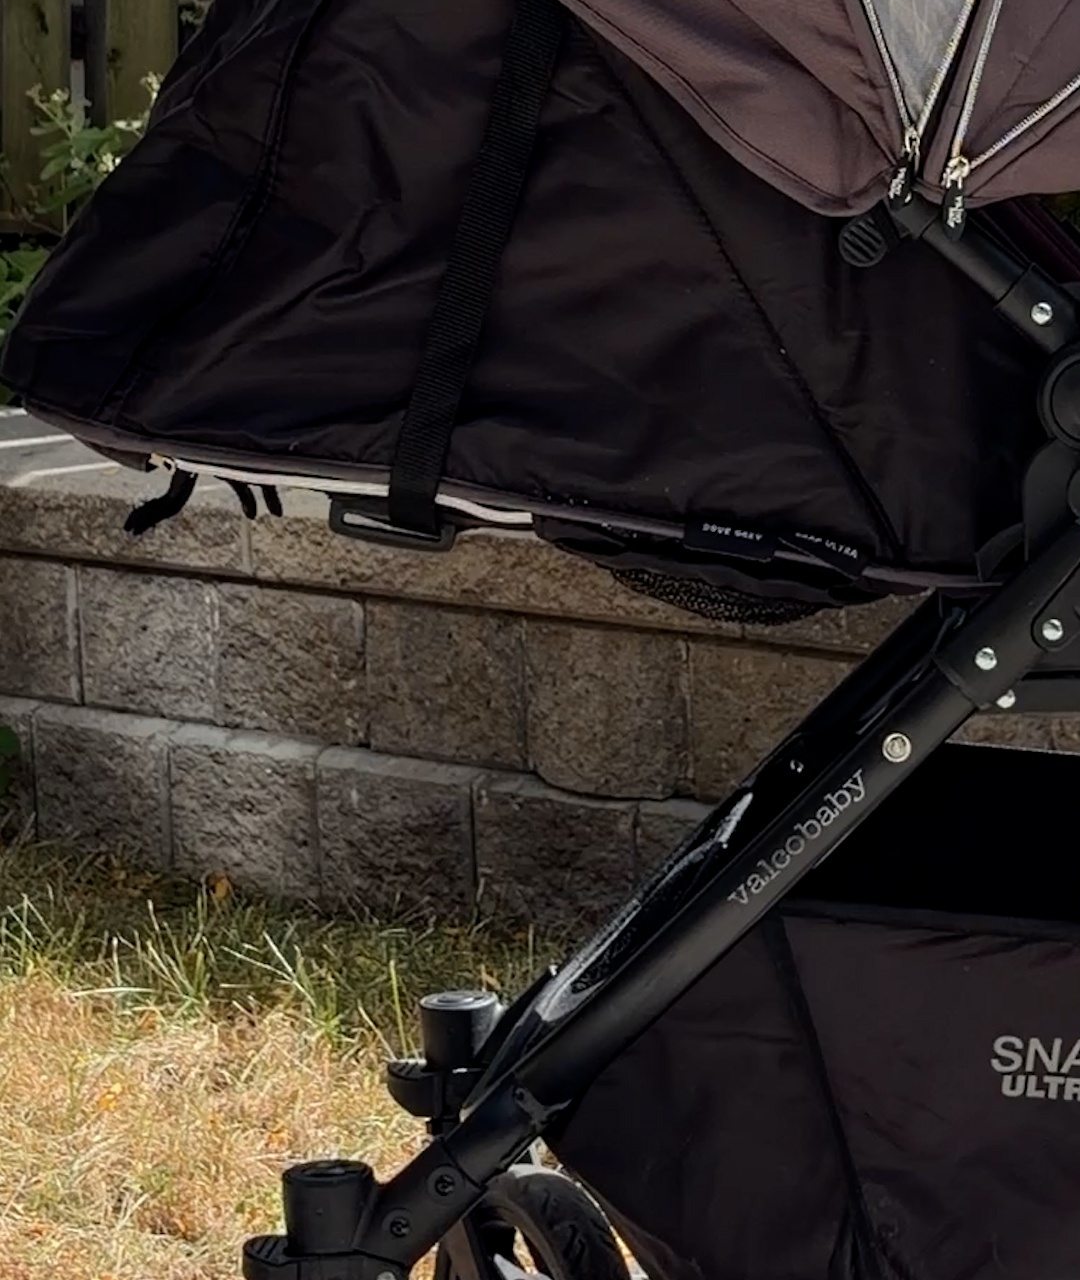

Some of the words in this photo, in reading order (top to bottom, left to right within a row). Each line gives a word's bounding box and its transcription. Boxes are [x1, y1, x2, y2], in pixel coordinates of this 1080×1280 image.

[702, 523, 731, 535] DOVE
[824, 539, 858, 559] ULTRA
[727, 768, 867, 905] valcobaby
